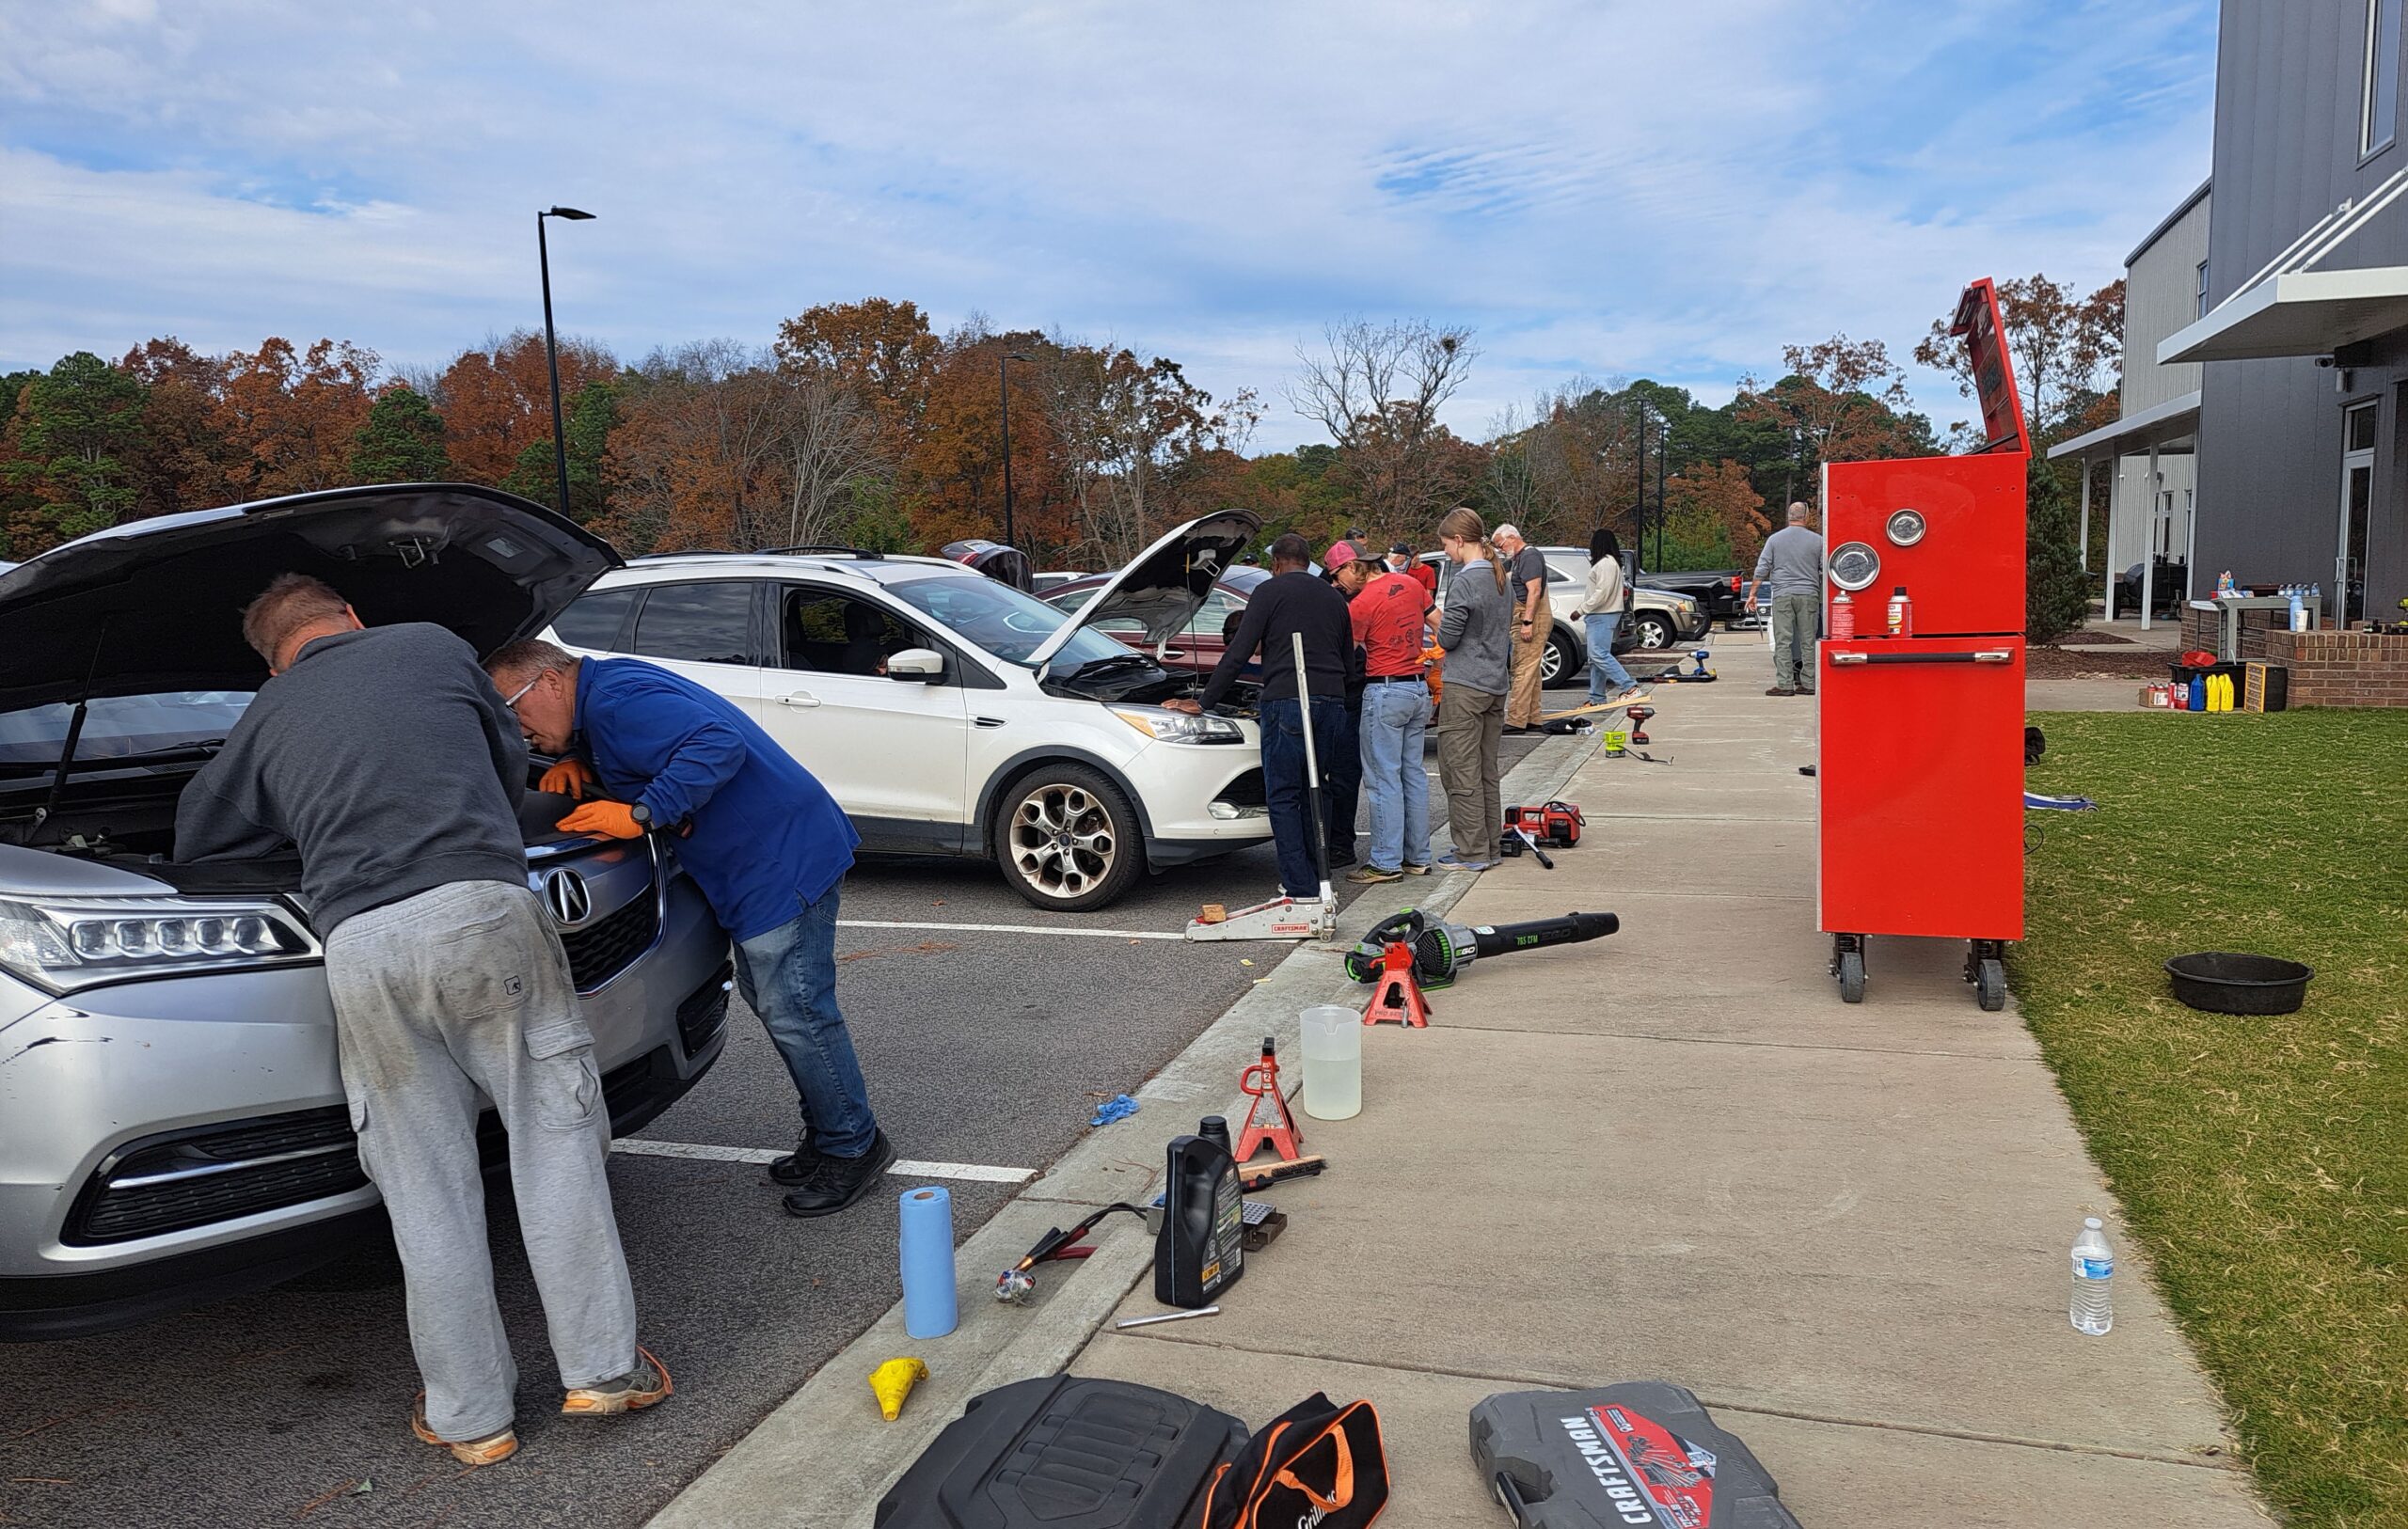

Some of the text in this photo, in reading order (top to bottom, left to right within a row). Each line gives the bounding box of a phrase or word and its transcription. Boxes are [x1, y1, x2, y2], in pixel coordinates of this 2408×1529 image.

[1527, 935, 1539, 944] CFM
[1455, 946, 1476, 957] EGO
[1560, 1416, 1653, 1524] CRAFTSMAN
